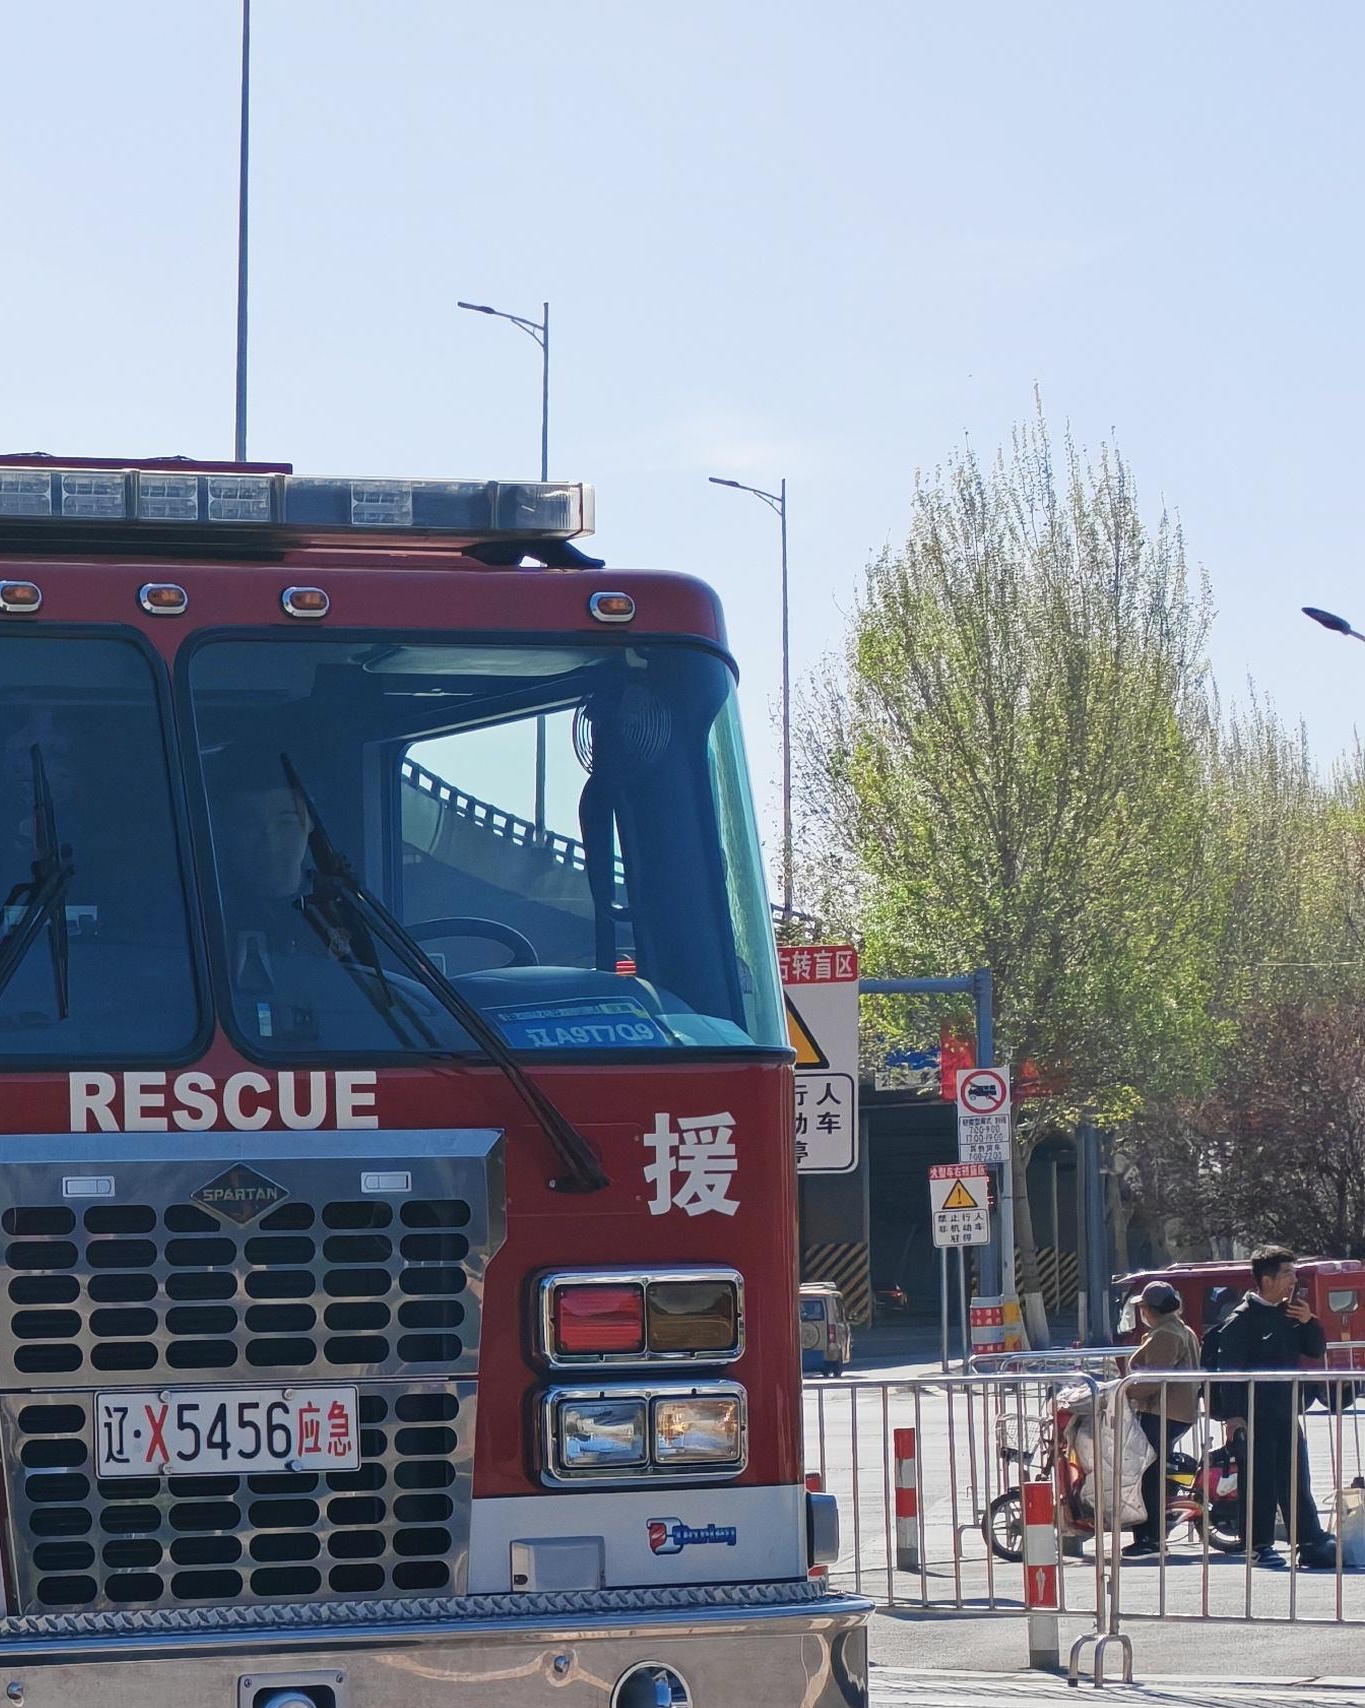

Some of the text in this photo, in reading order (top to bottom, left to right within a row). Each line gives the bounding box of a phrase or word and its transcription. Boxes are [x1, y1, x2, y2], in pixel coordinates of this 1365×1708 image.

[69, 1070, 380, 1132] RESCUE
[203, 1187, 278, 1201] SPARTAN
[643, 1111, 741, 1216] 援
